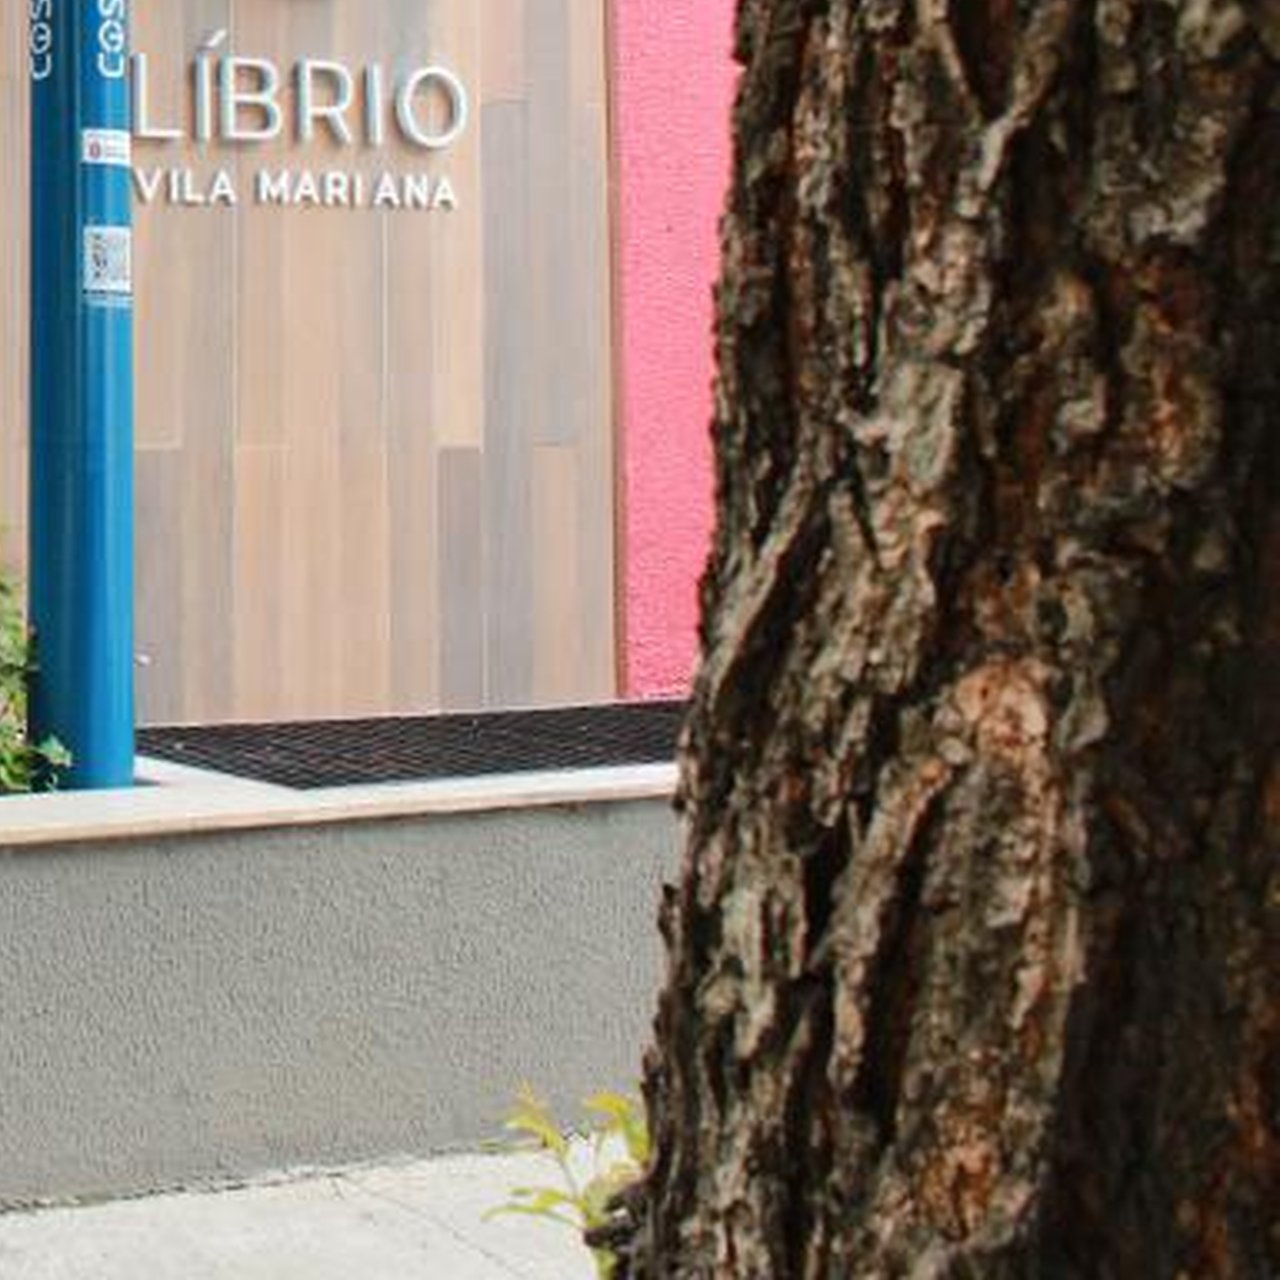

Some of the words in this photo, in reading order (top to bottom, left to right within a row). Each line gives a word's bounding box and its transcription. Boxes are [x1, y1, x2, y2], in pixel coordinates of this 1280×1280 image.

[130, 28, 469, 150] LÍBRIO
[133, 166, 238, 205] VILA
[255, 167, 459, 209] MARIANA
